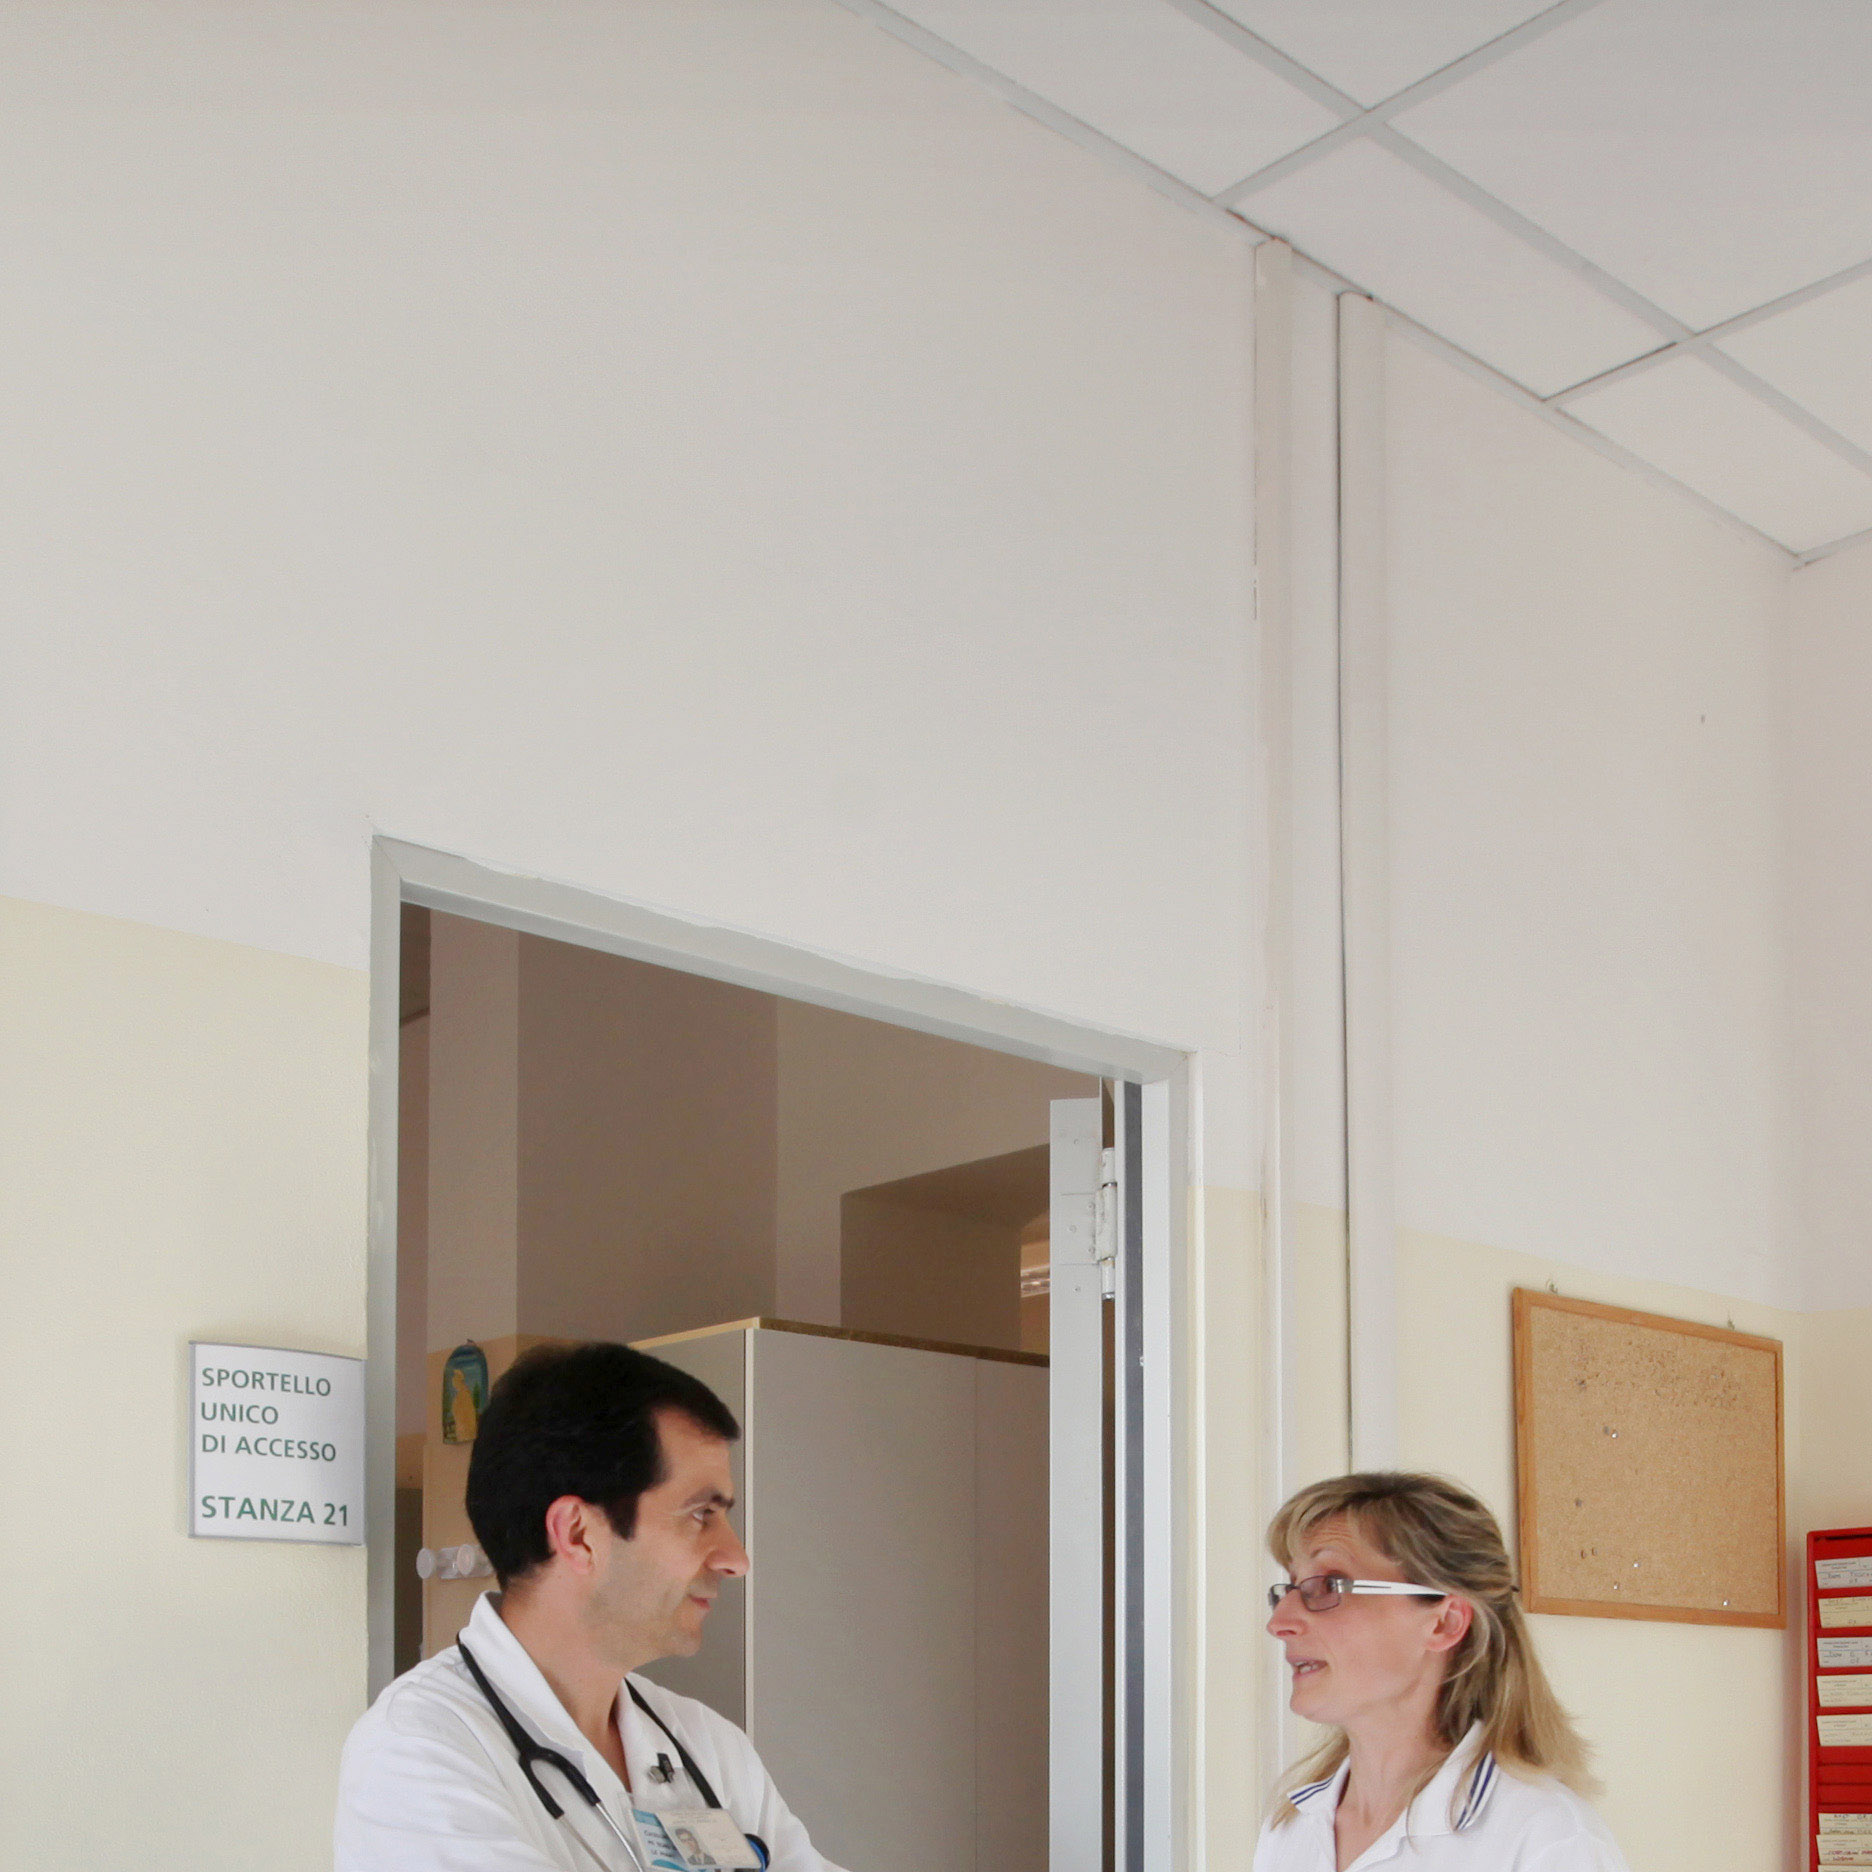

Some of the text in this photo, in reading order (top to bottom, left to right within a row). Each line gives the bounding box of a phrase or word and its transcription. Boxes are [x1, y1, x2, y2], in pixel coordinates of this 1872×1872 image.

[202, 1367, 331, 1396] SPORTELLO
[201, 1402, 278, 1425] UNICO
[202, 1434, 336, 1462] DI ACCESSO
[201, 1496, 347, 1527] STANZA 21
